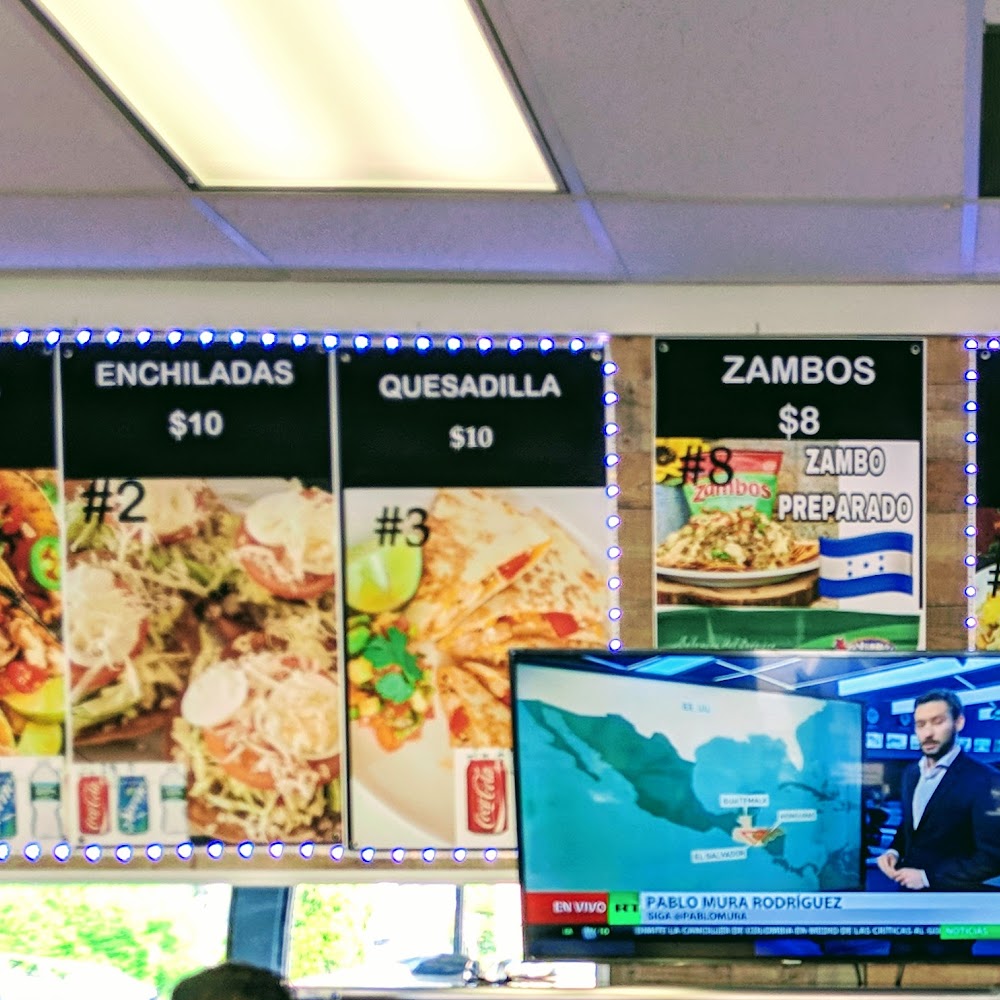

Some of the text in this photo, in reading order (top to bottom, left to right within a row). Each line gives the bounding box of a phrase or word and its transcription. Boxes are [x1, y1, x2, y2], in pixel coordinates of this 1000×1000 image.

[95, 359, 295, 387] ENCHILADAS
[721, 354, 876, 385] ZAMBOS
[378, 373, 562, 400] QUESADILLA
[168, 410, 224, 440] $10
[777, 402, 821, 442] $8
[449, 424, 495, 451] $10
[680, 445, 735, 486] #8
[803, 446, 886, 478] ZAMBO
[82, 477, 148, 523] #2
[777, 492, 914, 524] PREPARADO
[374, 505, 431, 549] #3
[574, 900, 607, 913] VIVO
[646, 894, 843, 910] PABLO MURA RODRÍGUEZ
[648, 911, 671, 921] SIGA
